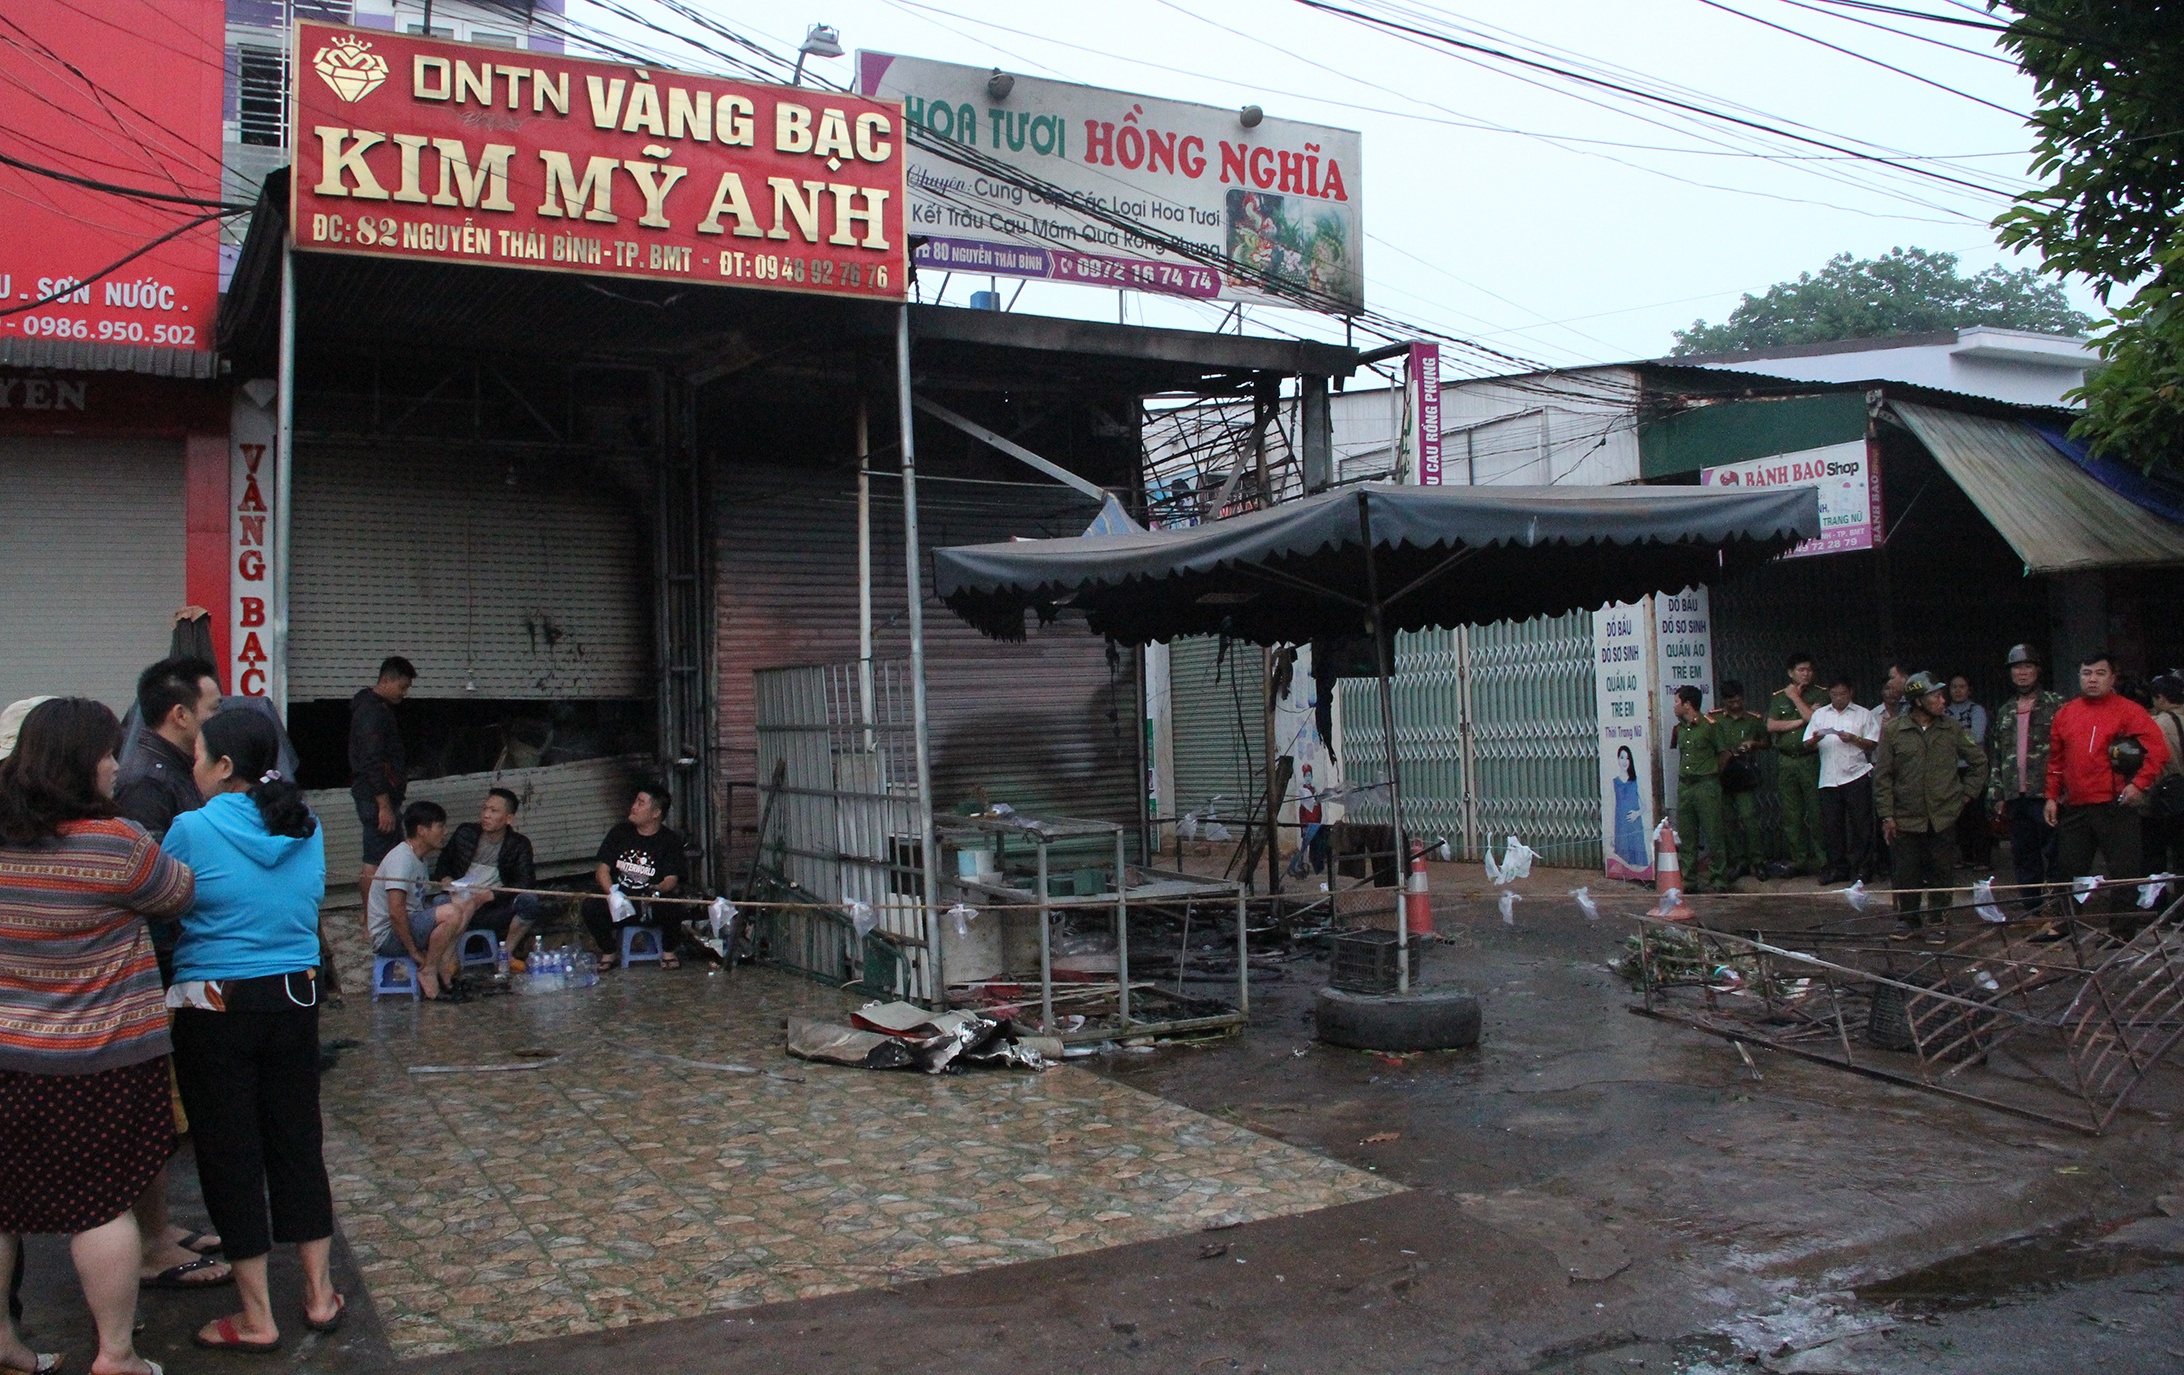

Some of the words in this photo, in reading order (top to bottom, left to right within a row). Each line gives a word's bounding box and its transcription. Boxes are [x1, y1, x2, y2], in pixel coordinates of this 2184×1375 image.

[413, 53, 569, 115] DNTN
[586, 70, 754, 147] VÀNG
[776, 101, 892, 172] BẠC
[905, 94, 976, 146] HOA
[987, 106, 1065, 158] TƯƠI
[1084, 104, 1206, 179] HỒNG
[1218, 142, 1348, 201] NGHĨA
[313, 126, 515, 212] KIM
[538, 144, 687, 228] MỸ
[698, 172, 890, 250] ANH
[974, 177, 1022, 206] Cung
[1113, 196, 1146, 221] Loại
[1152, 201, 1184, 222] Hoa
[1189, 206, 1220, 227] Tươi
[912, 203, 942, 225] Kết
[1033, 217, 1077, 240] Mâm
[312, 213, 351, 244] ĐC:
[356, 214, 398, 248] 82
[403, 217, 491, 255] NGUYỄN
[498, 227, 546, 260] THÁI
[867, 264, 888, 289] 76
[933, 241, 949, 262] 80
[952, 243, 992, 266] NGUYỄN
[993, 251, 1016, 268] THÁI
[1018, 253, 1043, 271] BÌNH
[37, 275, 90, 305] SƠN
[1160, 266, 1183, 287] 74
[1189, 269, 1212, 290] 74
[23, 315, 196, 345] 0986.950.502
[1422, 357, 1440, 403] PHỤNG
[1421, 406, 1438, 442] RỒNG
[1425, 446, 1440, 474] CAU
[1745, 465, 1788, 486] BÁNH
[1792, 459, 1825, 482] BAO
[1826, 460, 1859, 476] Shop
[238, 443, 267, 581] VÀNG
[1823, 514, 1849, 526] TRANG
[1811, 542, 1824, 550] 72
[1827, 540, 1840, 549] 28
[1844, 538, 1858, 547] 79
[1849, 528, 1865, 536] BMT
[1689, 619, 1706, 633] SINH
[238, 597, 267, 697] BẠC
[1623, 645, 1638, 661] SINH
[1693, 640, 1705, 657] ÁO
[1627, 671, 1637, 691] ÁO
[1690, 666, 1701, 679] EM
[1625, 701, 1634, 716] EM
